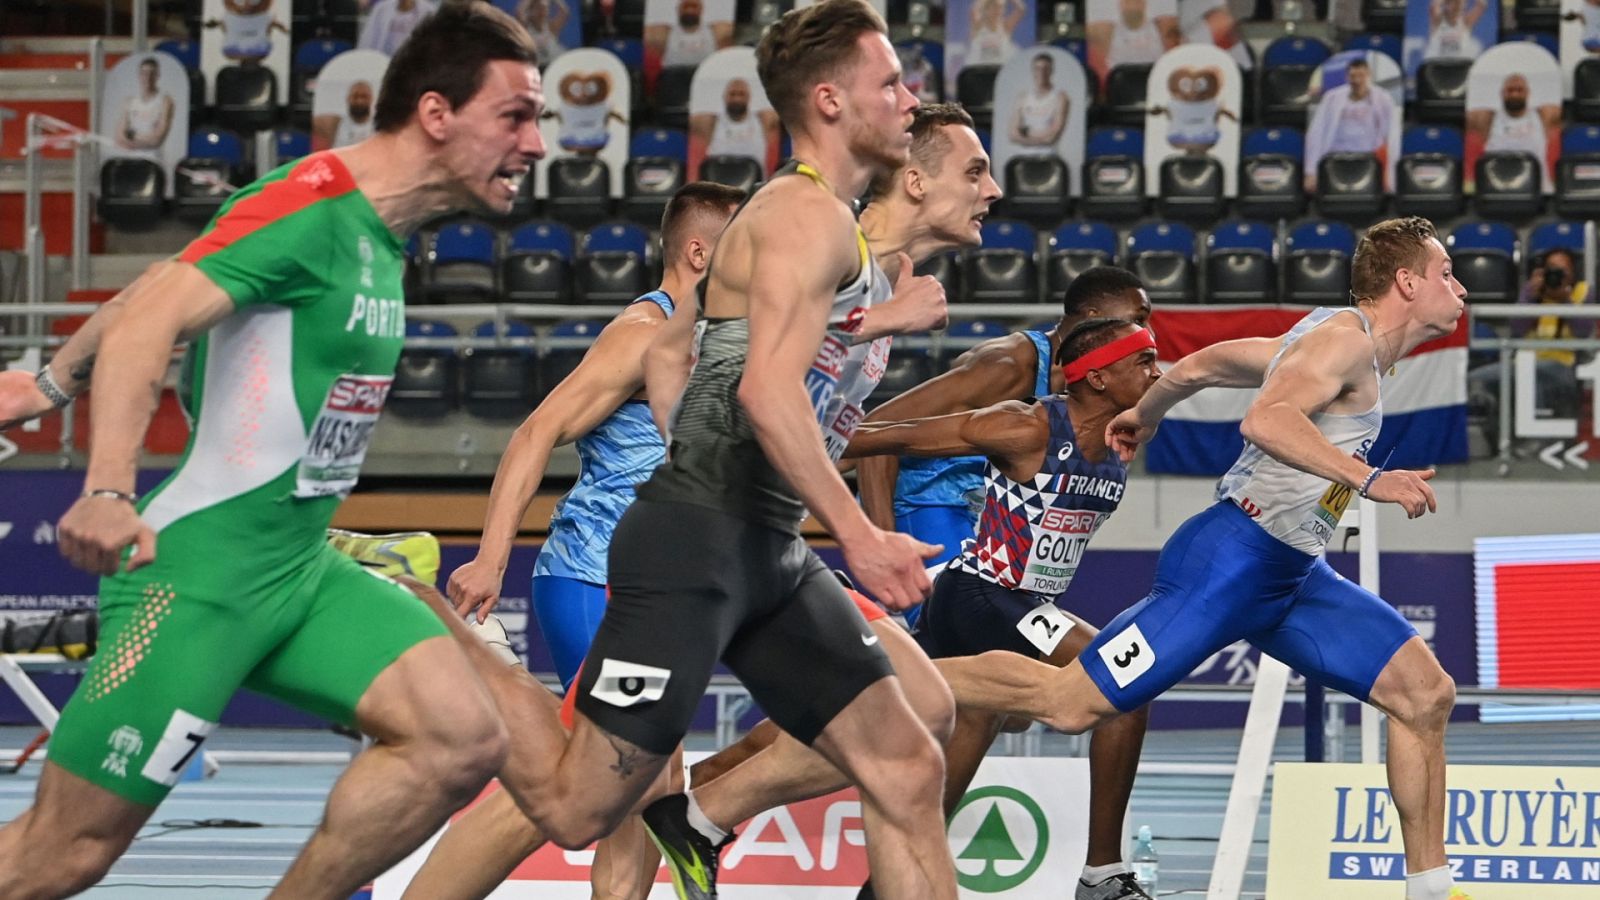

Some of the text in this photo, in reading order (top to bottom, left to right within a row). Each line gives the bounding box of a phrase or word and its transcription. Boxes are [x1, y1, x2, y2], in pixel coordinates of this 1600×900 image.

[1066, 475, 1124, 502] FRANCE
[1326, 481, 1352, 512] VO
[1044, 512, 1093, 531] SPAR
[1031, 614, 1060, 640] 2
[1113, 641, 1141, 669] 3
[170, 731, 206, 773] 7
[1331, 786, 1393, 844] LE
